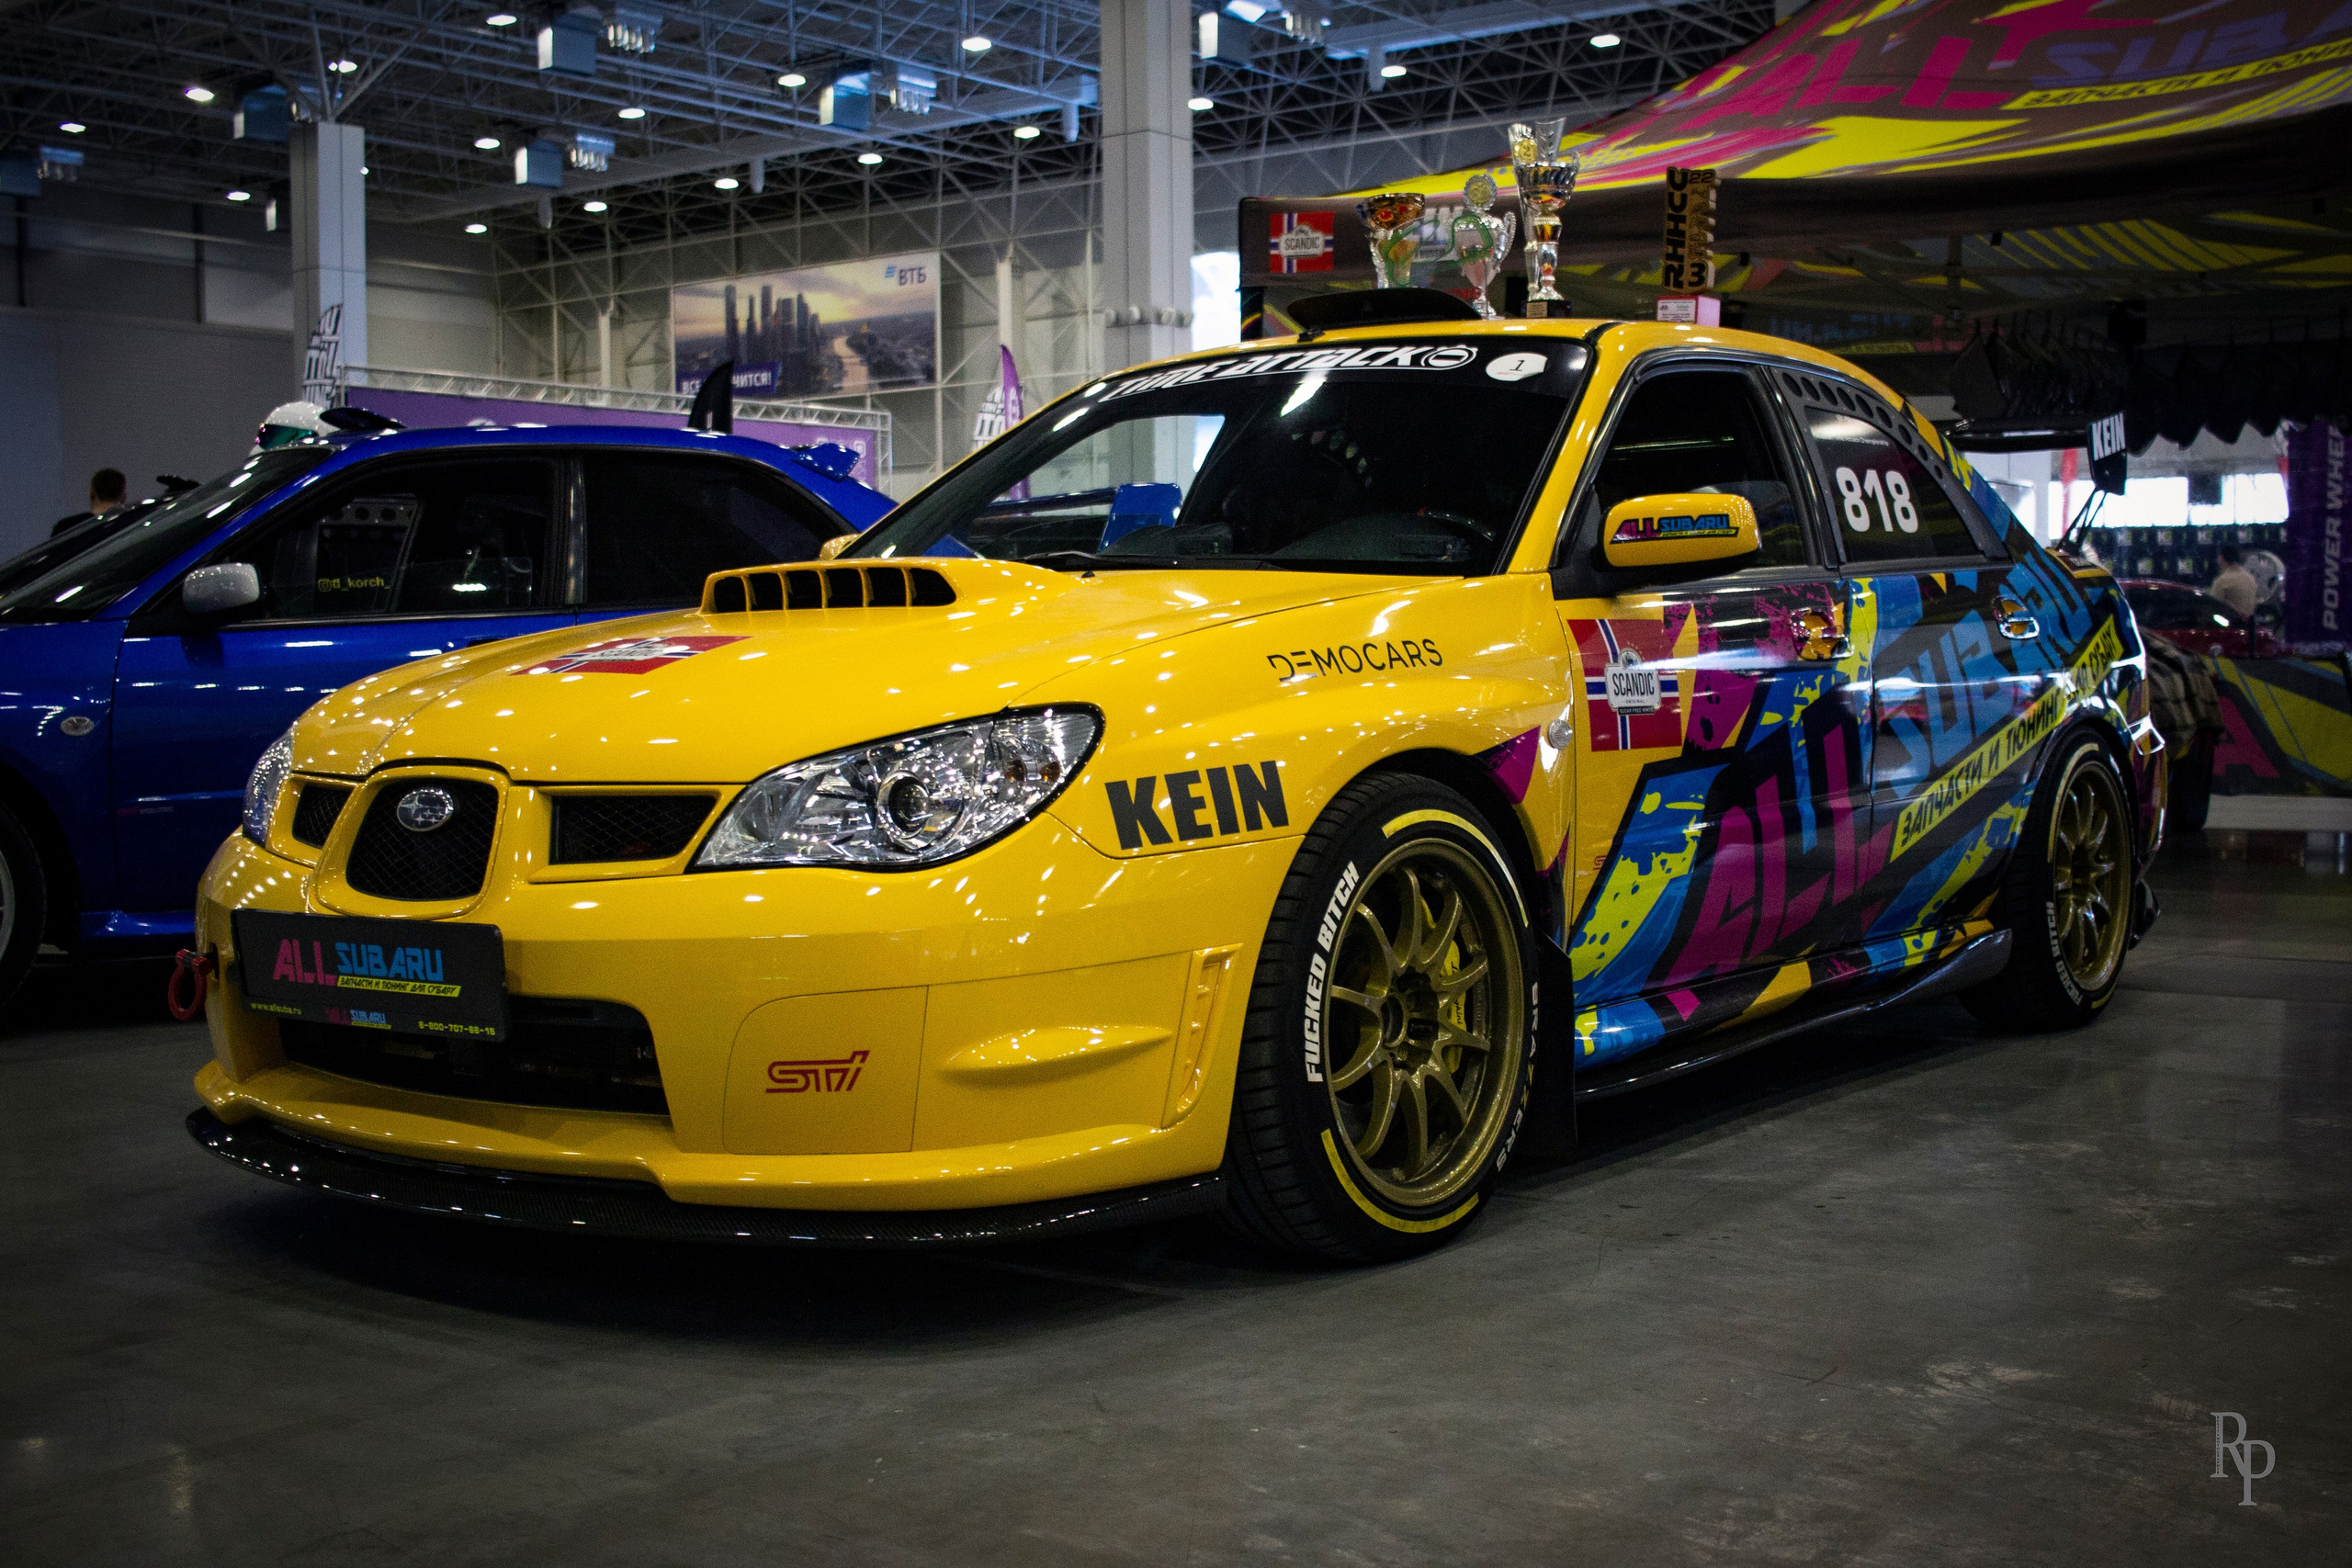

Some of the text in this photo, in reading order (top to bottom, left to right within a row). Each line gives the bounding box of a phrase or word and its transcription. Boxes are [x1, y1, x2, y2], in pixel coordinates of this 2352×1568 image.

[1285, 235, 1321, 251] SCANDIC
[898, 266, 927, 286] ВТБ
[731, 371, 773, 389] ЧИТСЯ!
[1509, 359, 1525, 372] 1
[2091, 412, 2126, 462] KEIN
[1836, 467, 1918, 533] 818
[1612, 519, 1660, 541] ALL
[1660, 515, 1727, 533] SUBARU
[2322, 517, 2342, 631] POWER
[1266, 638, 1444, 682] DEMOCARS
[1611, 672, 1655, 696] SCANDIC
[1874, 549, 2092, 797] SUBARU
[1901, 754, 1984, 847] ЗАПЧАСТИ
[1986, 739, 1999, 773] И
[2007, 687, 2061, 761] ТЮНИНГ
[1105, 760, 1290, 852] KEIN
[273, 938, 445, 987] ALL SUBARU
[340, 976, 373, 989] ЗАПЧАСТИ
[427, 985, 457, 995] СУБАРУ
[1304, 861, 1360, 1083] FUCKED BITCH
[1496, 981, 1539, 1172] BRAZZERS
